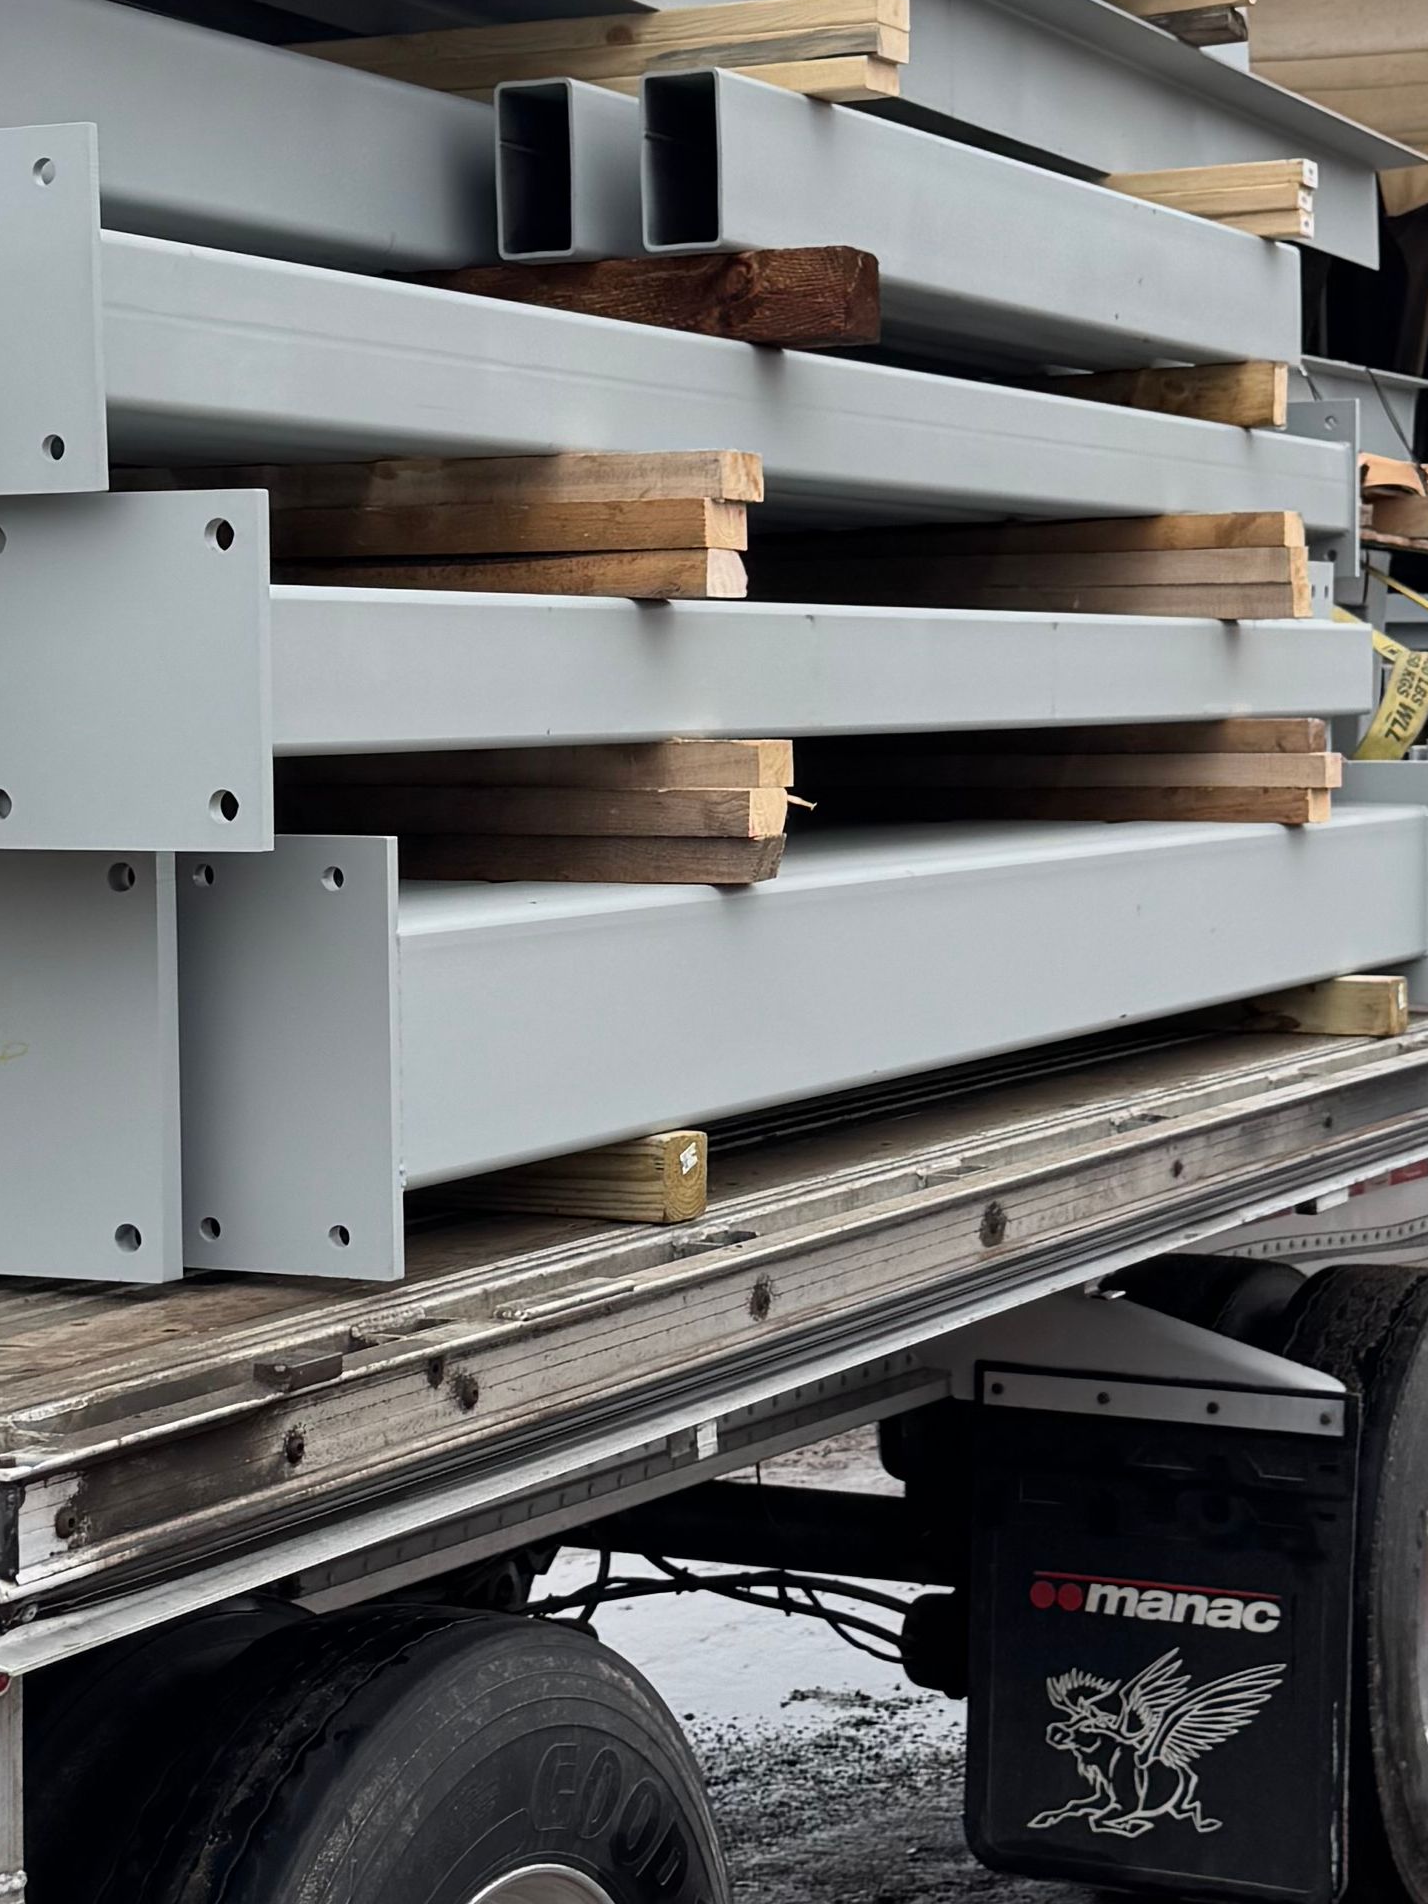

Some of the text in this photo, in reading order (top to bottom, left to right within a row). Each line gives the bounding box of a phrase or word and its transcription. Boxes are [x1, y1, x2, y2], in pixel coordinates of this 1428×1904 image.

[1396, 668, 1418, 698] KGS
[1385, 702, 1416, 742] WLL
[1084, 1583, 1282, 1634] manac
